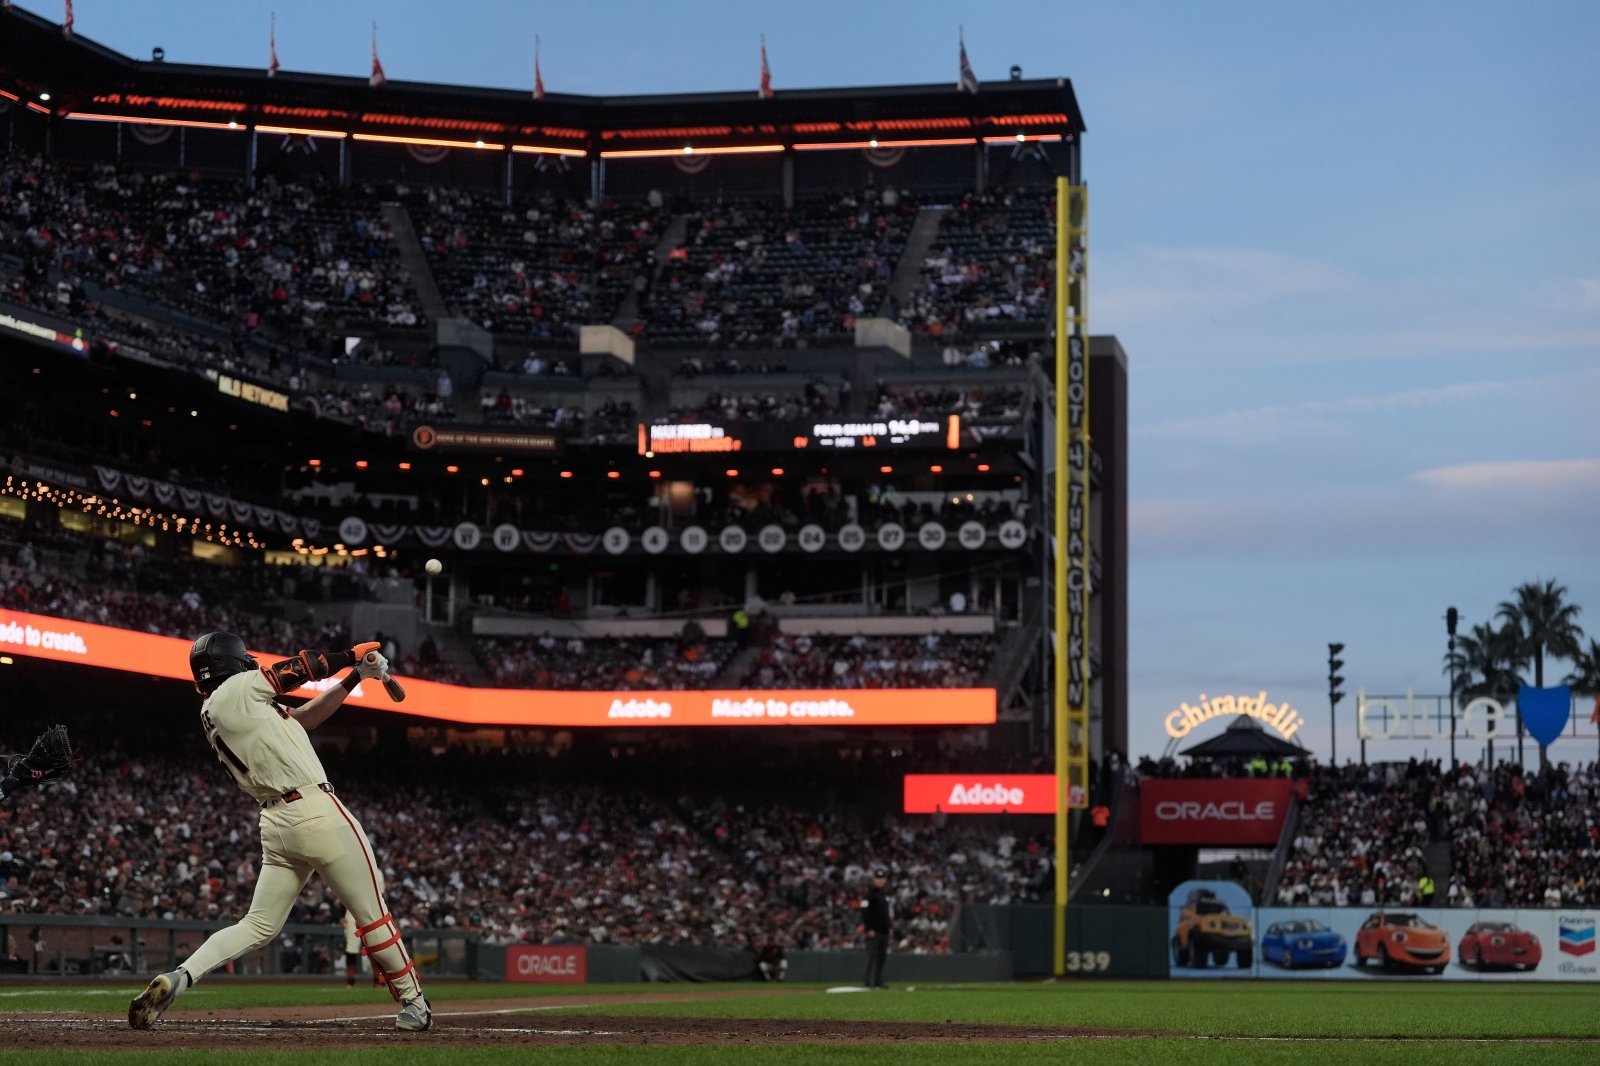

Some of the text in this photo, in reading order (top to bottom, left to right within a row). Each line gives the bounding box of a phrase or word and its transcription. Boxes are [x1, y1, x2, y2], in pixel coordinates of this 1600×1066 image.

[1003, 528, 1022, 540] 44
[0, 621, 24, 645] ade
[608, 700, 672, 718] Adobe
[712, 699, 854, 717] Made to create.
[1164, 690, 1305, 740] Ghirardelli
[949, 783, 1025, 806] Adobe
[1155, 801, 1275, 820] ORACLE
[518, 954, 577, 975] ORACLE
[1067, 951, 1111, 970] 339
